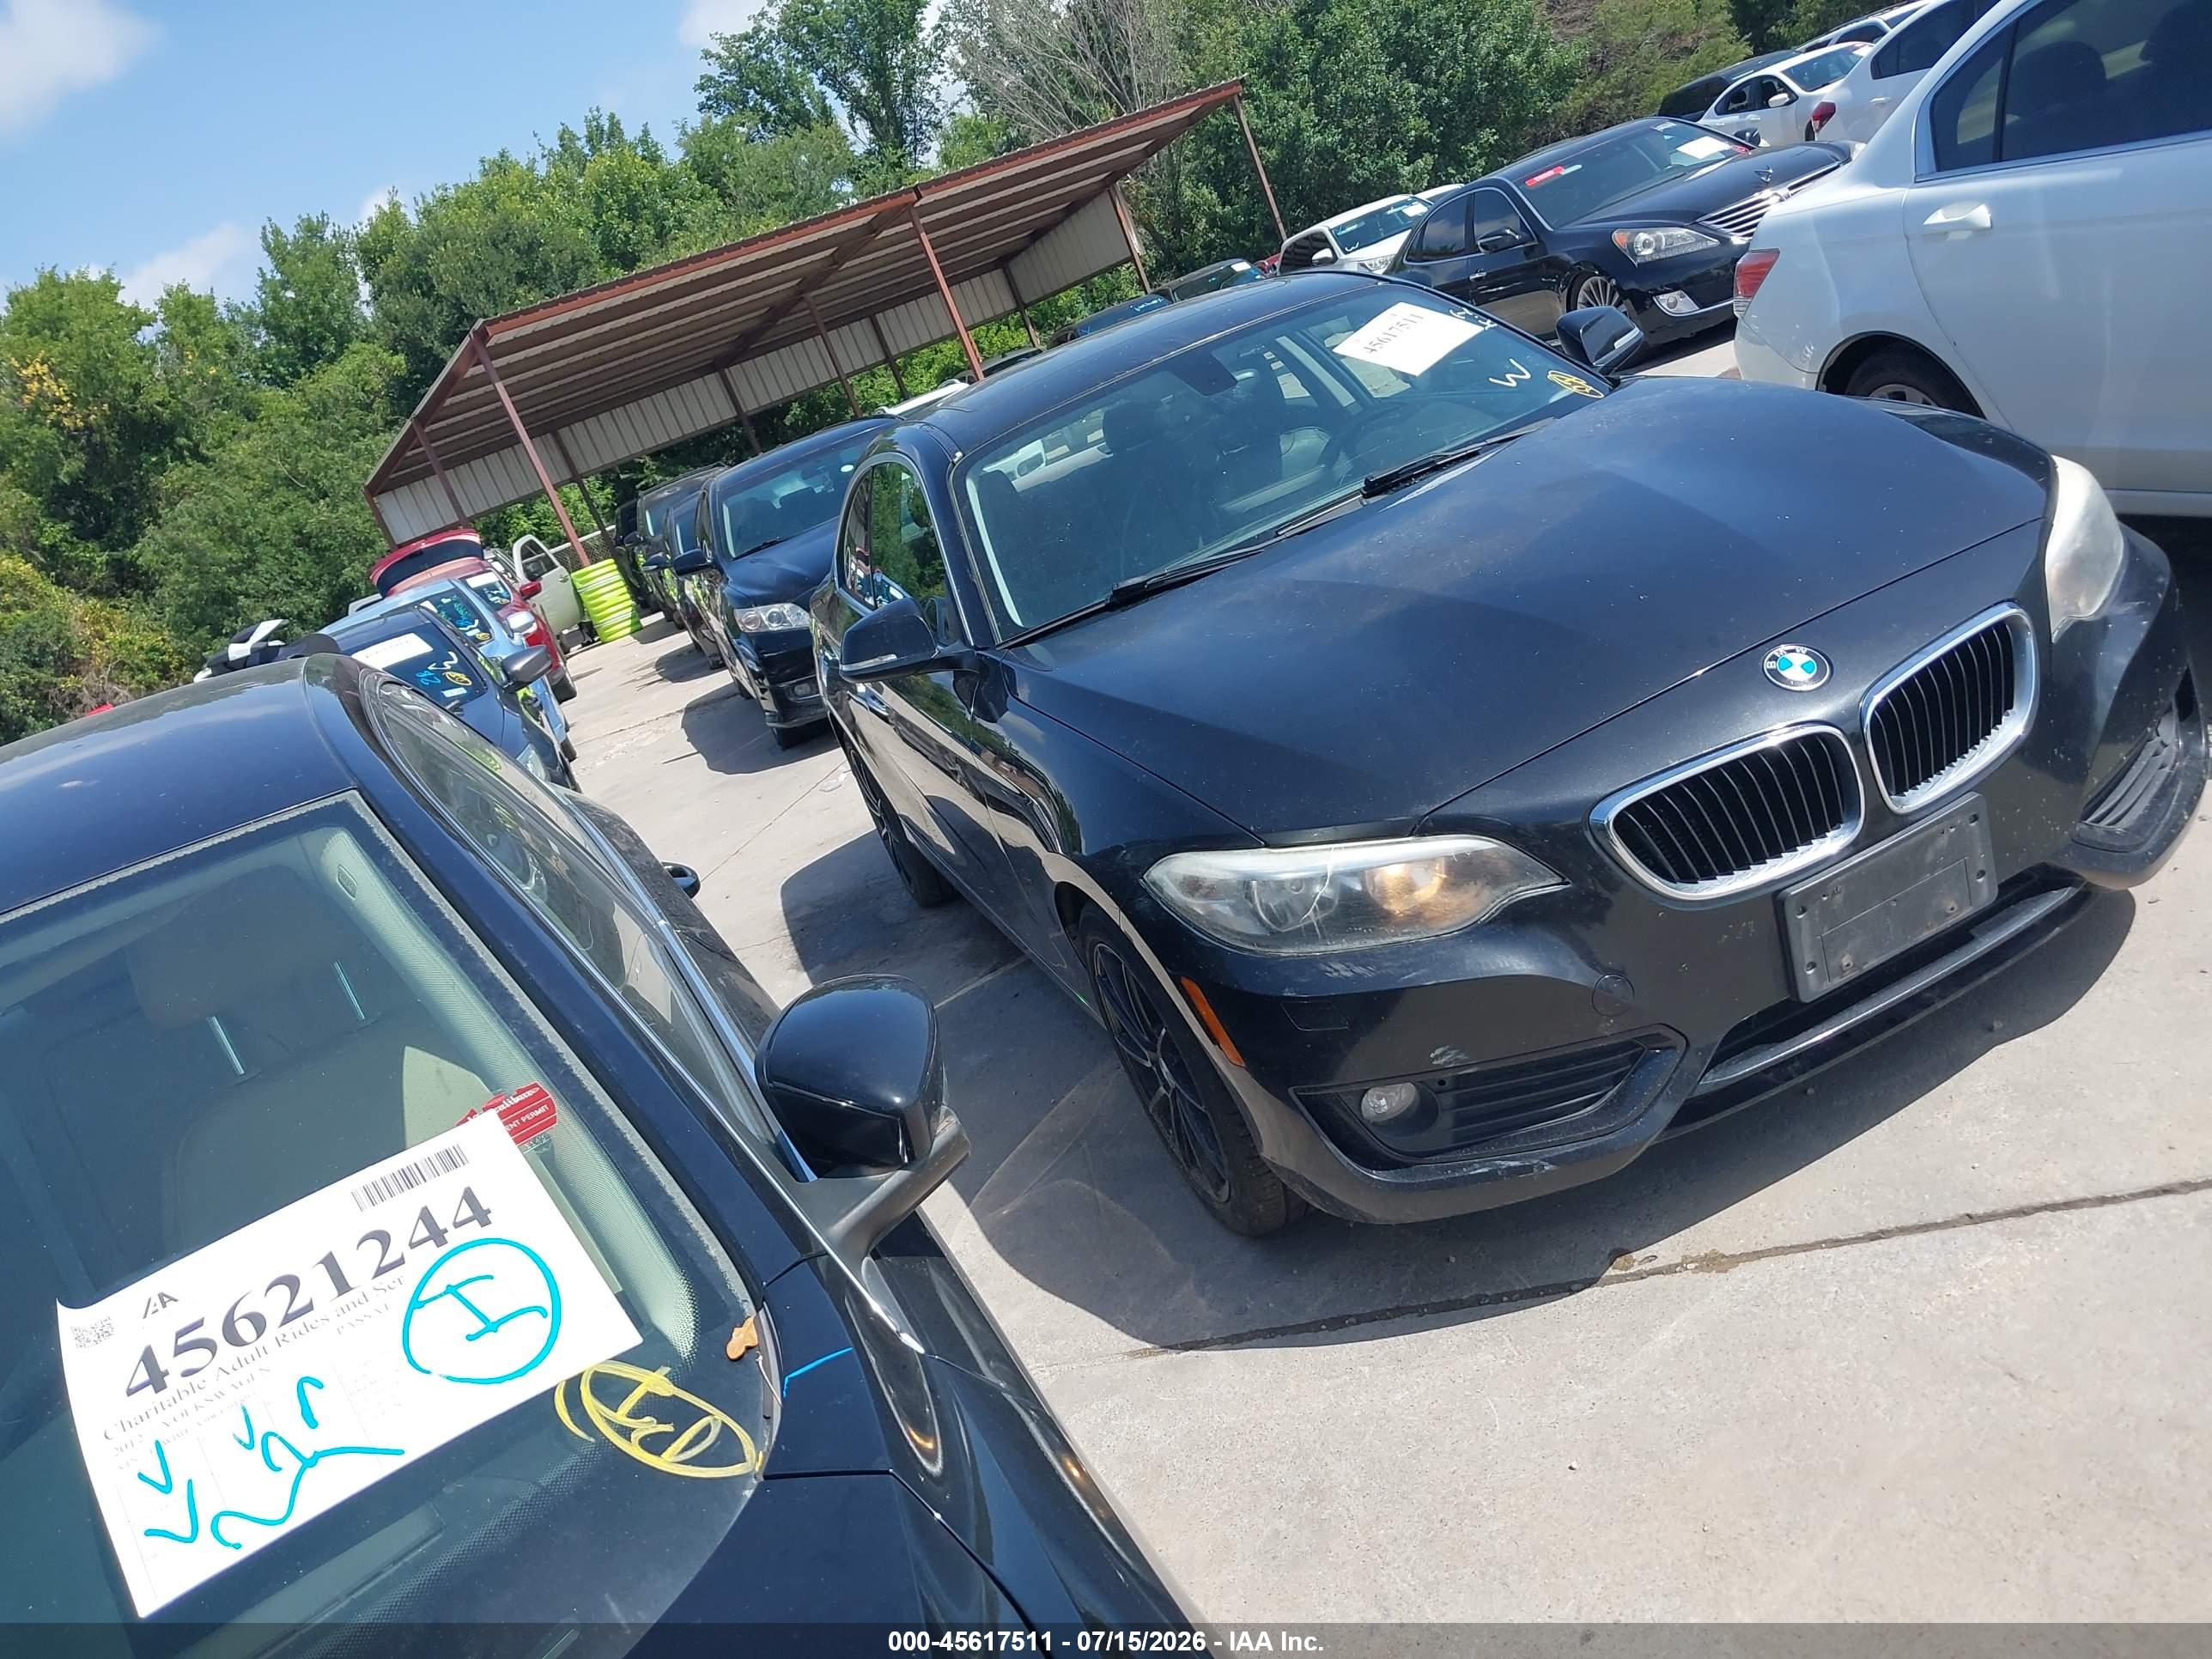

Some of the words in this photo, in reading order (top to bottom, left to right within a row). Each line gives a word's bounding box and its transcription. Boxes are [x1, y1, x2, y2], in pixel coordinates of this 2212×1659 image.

[1766, 647, 1808, 669] BMW
[521, 1104, 550, 1123] PERMIT
[126, 1186, 493, 1397] 45621244
[104, 1379, 207, 1440] Charitable
[216, 1345, 269, 1382] Adult
[275, 1316, 331, 1348] Rides
[336, 1291, 369, 1317] and
